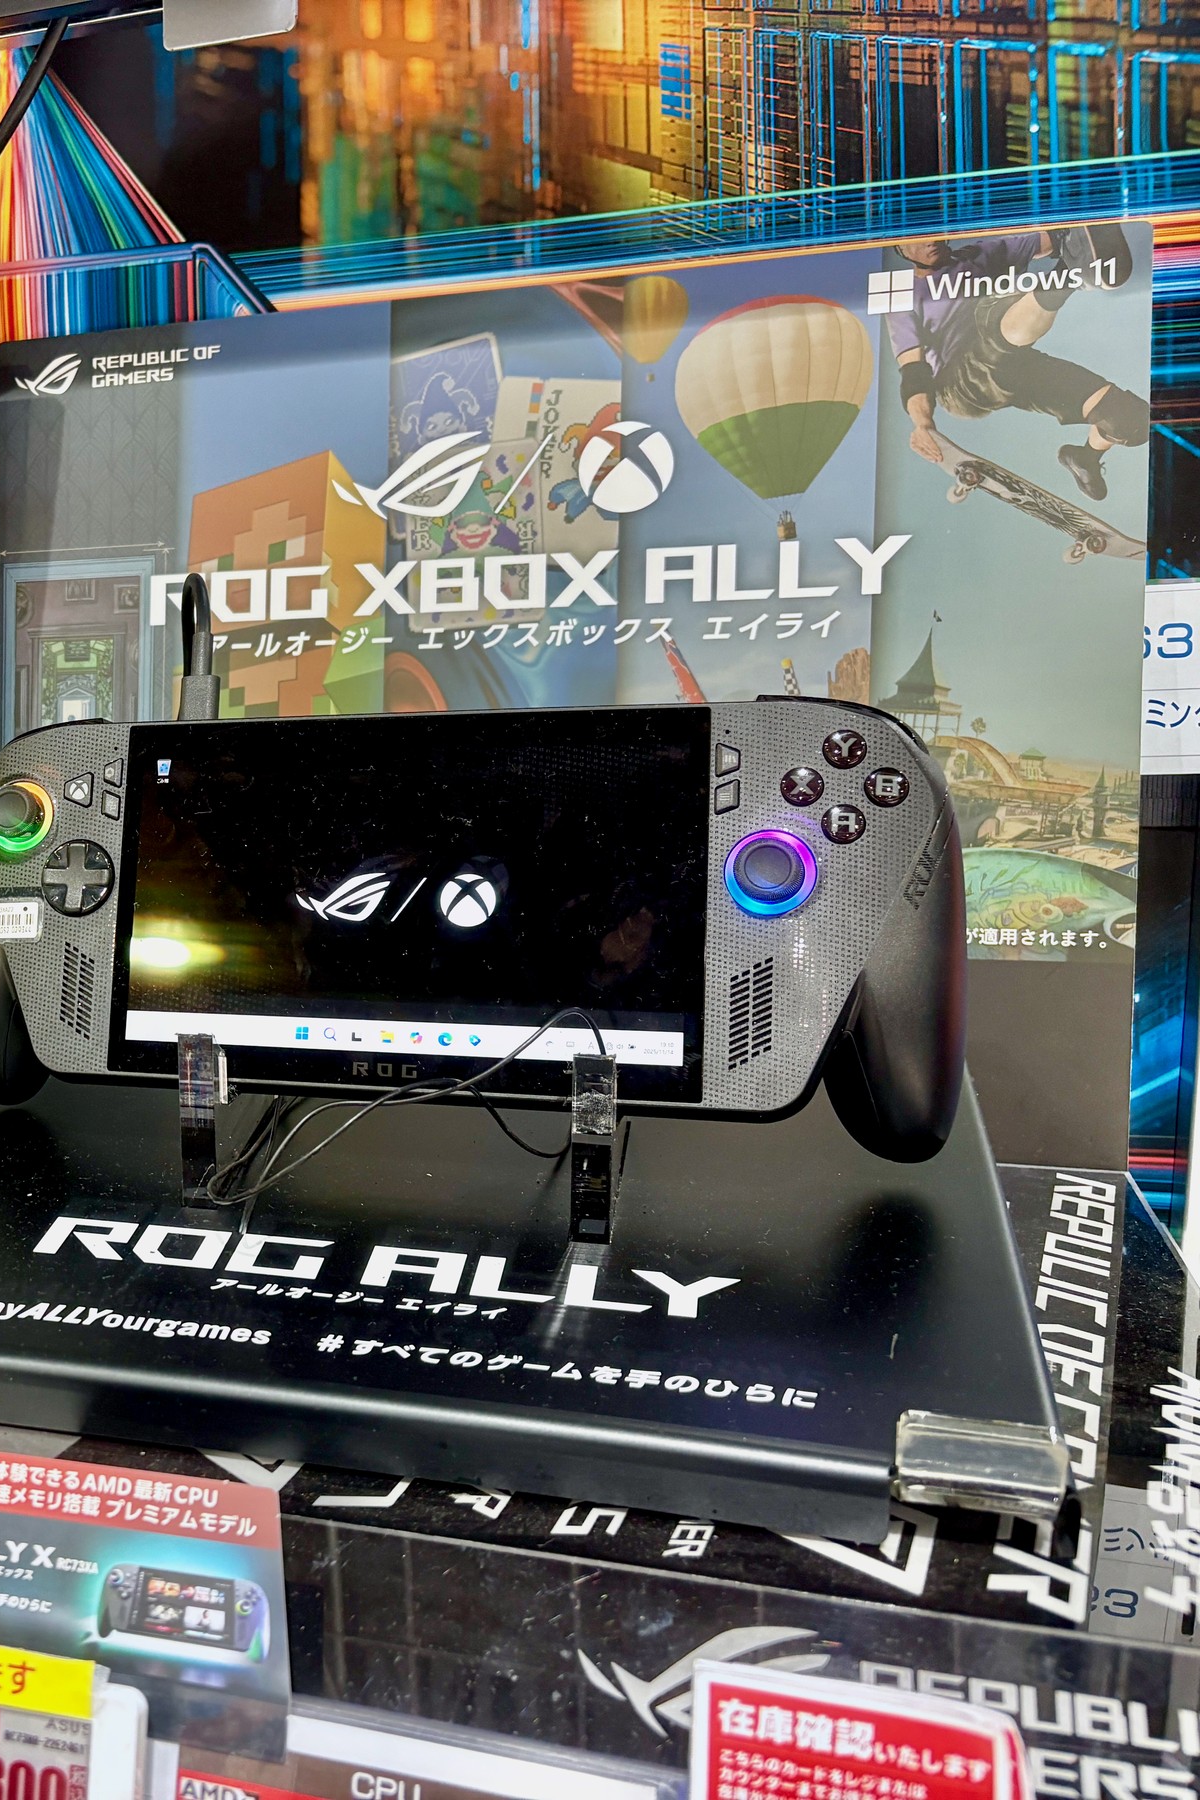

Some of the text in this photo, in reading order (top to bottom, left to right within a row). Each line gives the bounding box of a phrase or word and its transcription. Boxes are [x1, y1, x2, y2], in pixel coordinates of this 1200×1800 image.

[925, 257, 1119, 301] Windows 11
[91, 344, 222, 372] REPUBLIC OF
[91, 367, 175, 389] GAMERS
[149, 533, 914, 627] ROG XBOX ALLY
[418, 618, 675, 652] エックスボックス
[701, 609, 843, 642] エイライ
[1143, 621, 1195, 660] 3
[833, 736, 858, 757] Y
[789, 775, 815, 795] X
[875, 773, 901, 797] B
[830, 812, 857, 834] A
[351, 1060, 421, 1079] ROG
[32, 1215, 741, 1319] ROG ALLY
[210, 1276, 508, 1321] アールオージー エイライ
[32, 1546, 58, 1569] X
[716, 1698, 993, 1784] 在庫確認いたします
[351, 1771, 422, 1800] CPU
